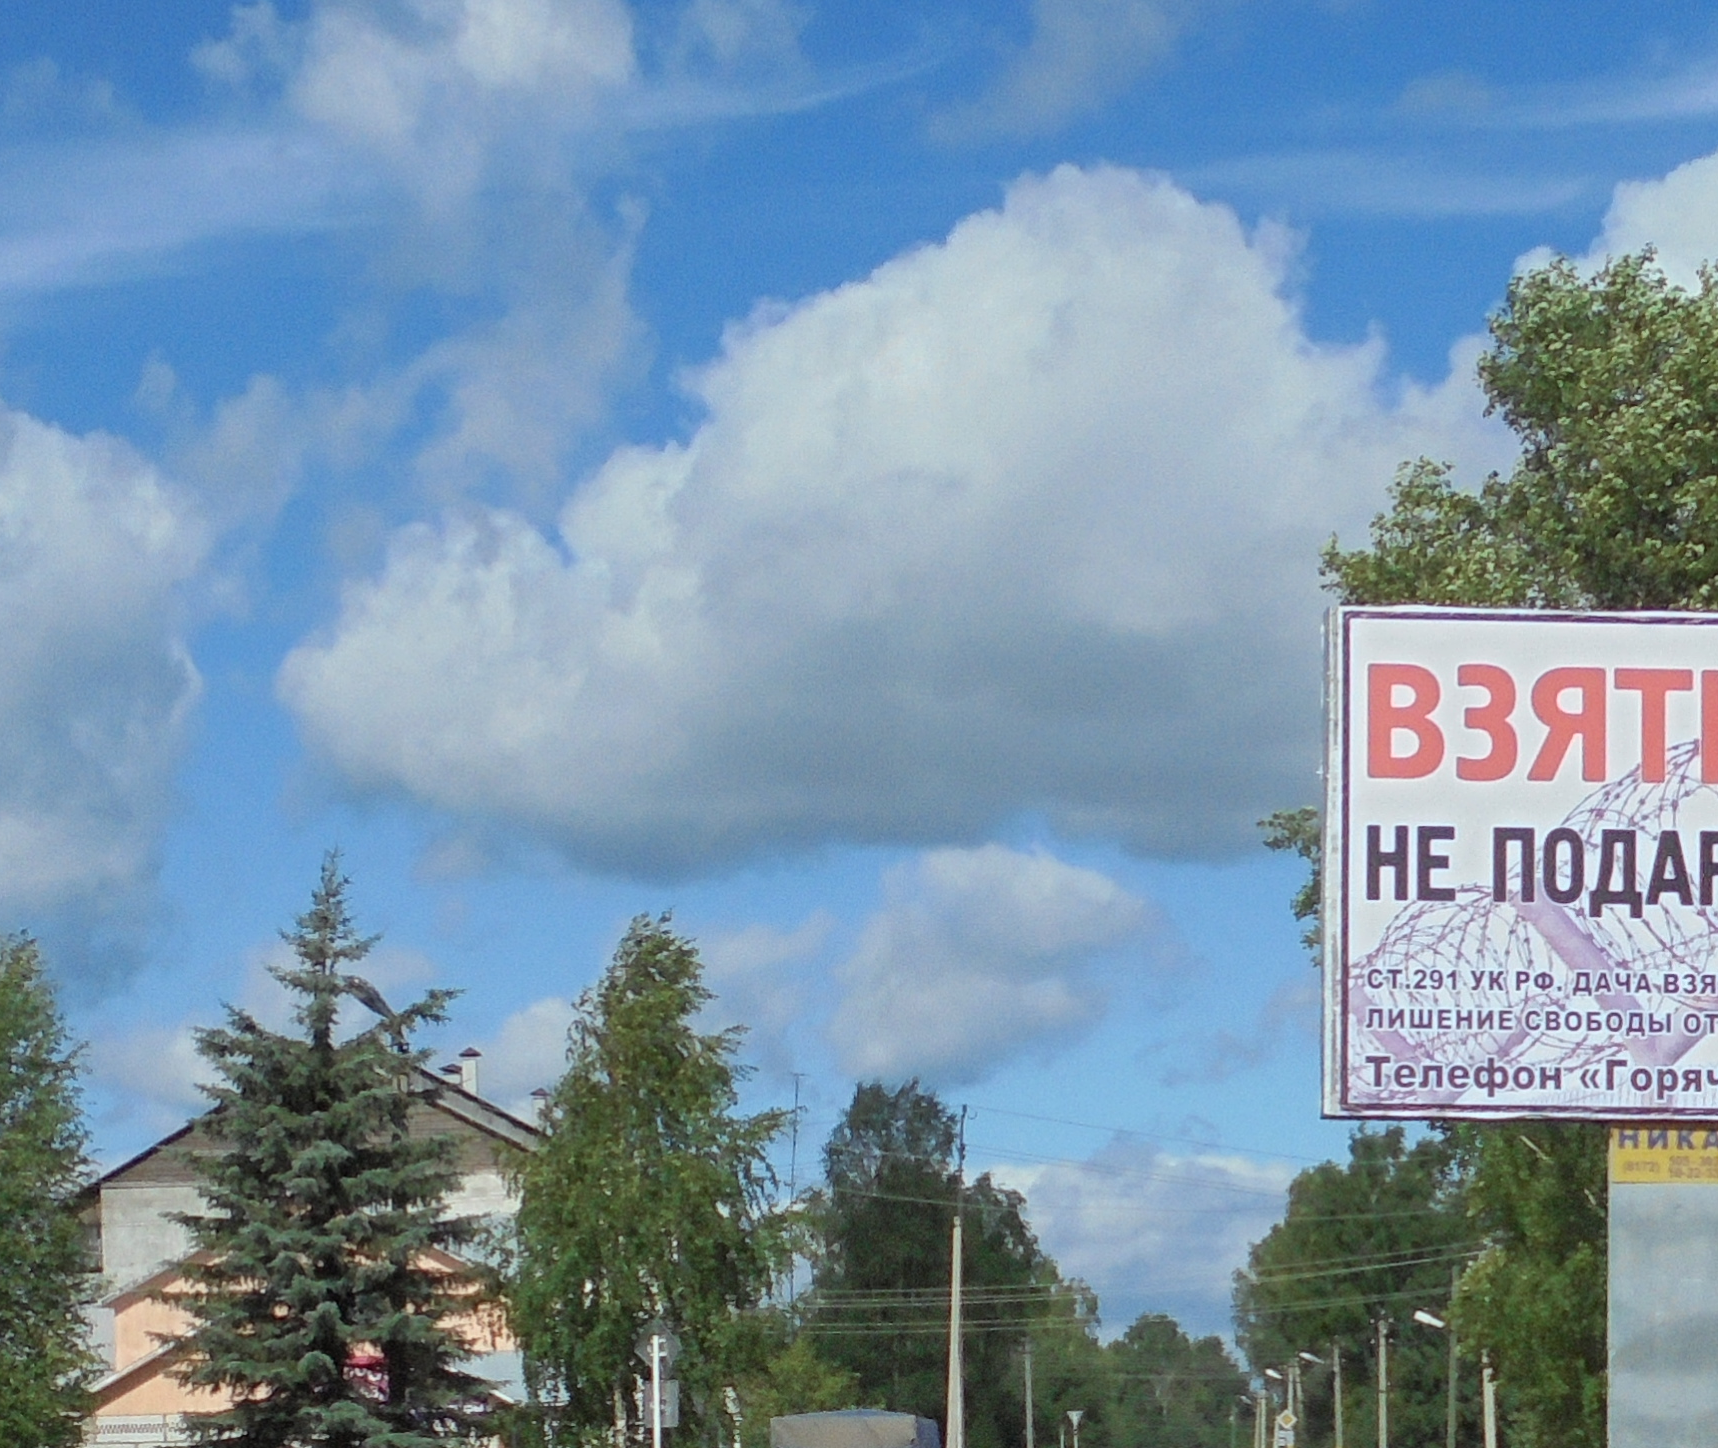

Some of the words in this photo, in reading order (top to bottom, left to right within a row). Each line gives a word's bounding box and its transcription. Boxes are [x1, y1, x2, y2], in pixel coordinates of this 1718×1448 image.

[1366, 825, 1455, 902] НЕ
[1366, 968, 1458, 991] СТ.291
[1470, 970, 1505, 992] УК
[1515, 970, 1562, 995] РФ.
[1572, 971, 1652, 997] ДАЧА
[1366, 1008, 1514, 1032] ЛИШЕНИЕ
[1524, 1009, 1672, 1037] СВОБОДЫ
[1365, 1055, 1562, 1098] Телефон
